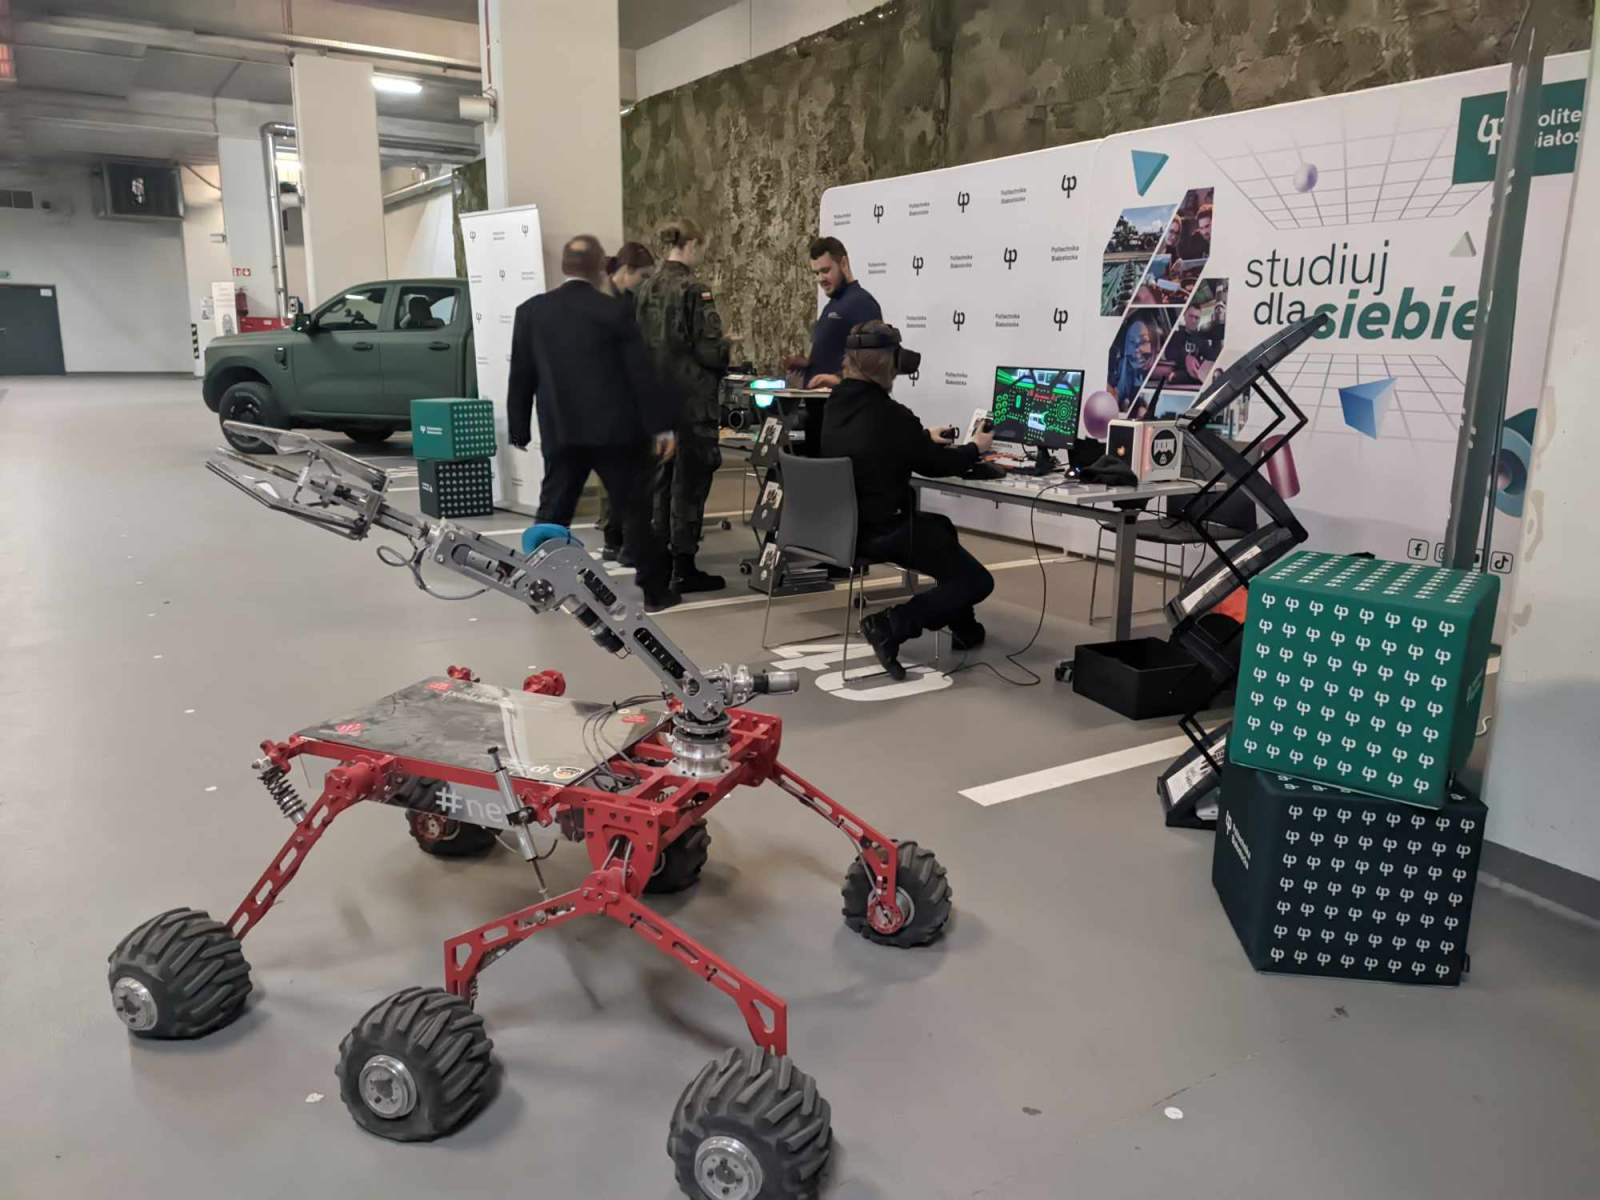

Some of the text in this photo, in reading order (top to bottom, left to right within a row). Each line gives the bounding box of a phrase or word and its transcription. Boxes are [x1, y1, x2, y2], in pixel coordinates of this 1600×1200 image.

[1538, 108, 1582, 127] olite
[1245, 239, 1389, 296] studiuj
[1254, 286, 1477, 340] dla siebie
[435, 786, 508, 823] #ne
